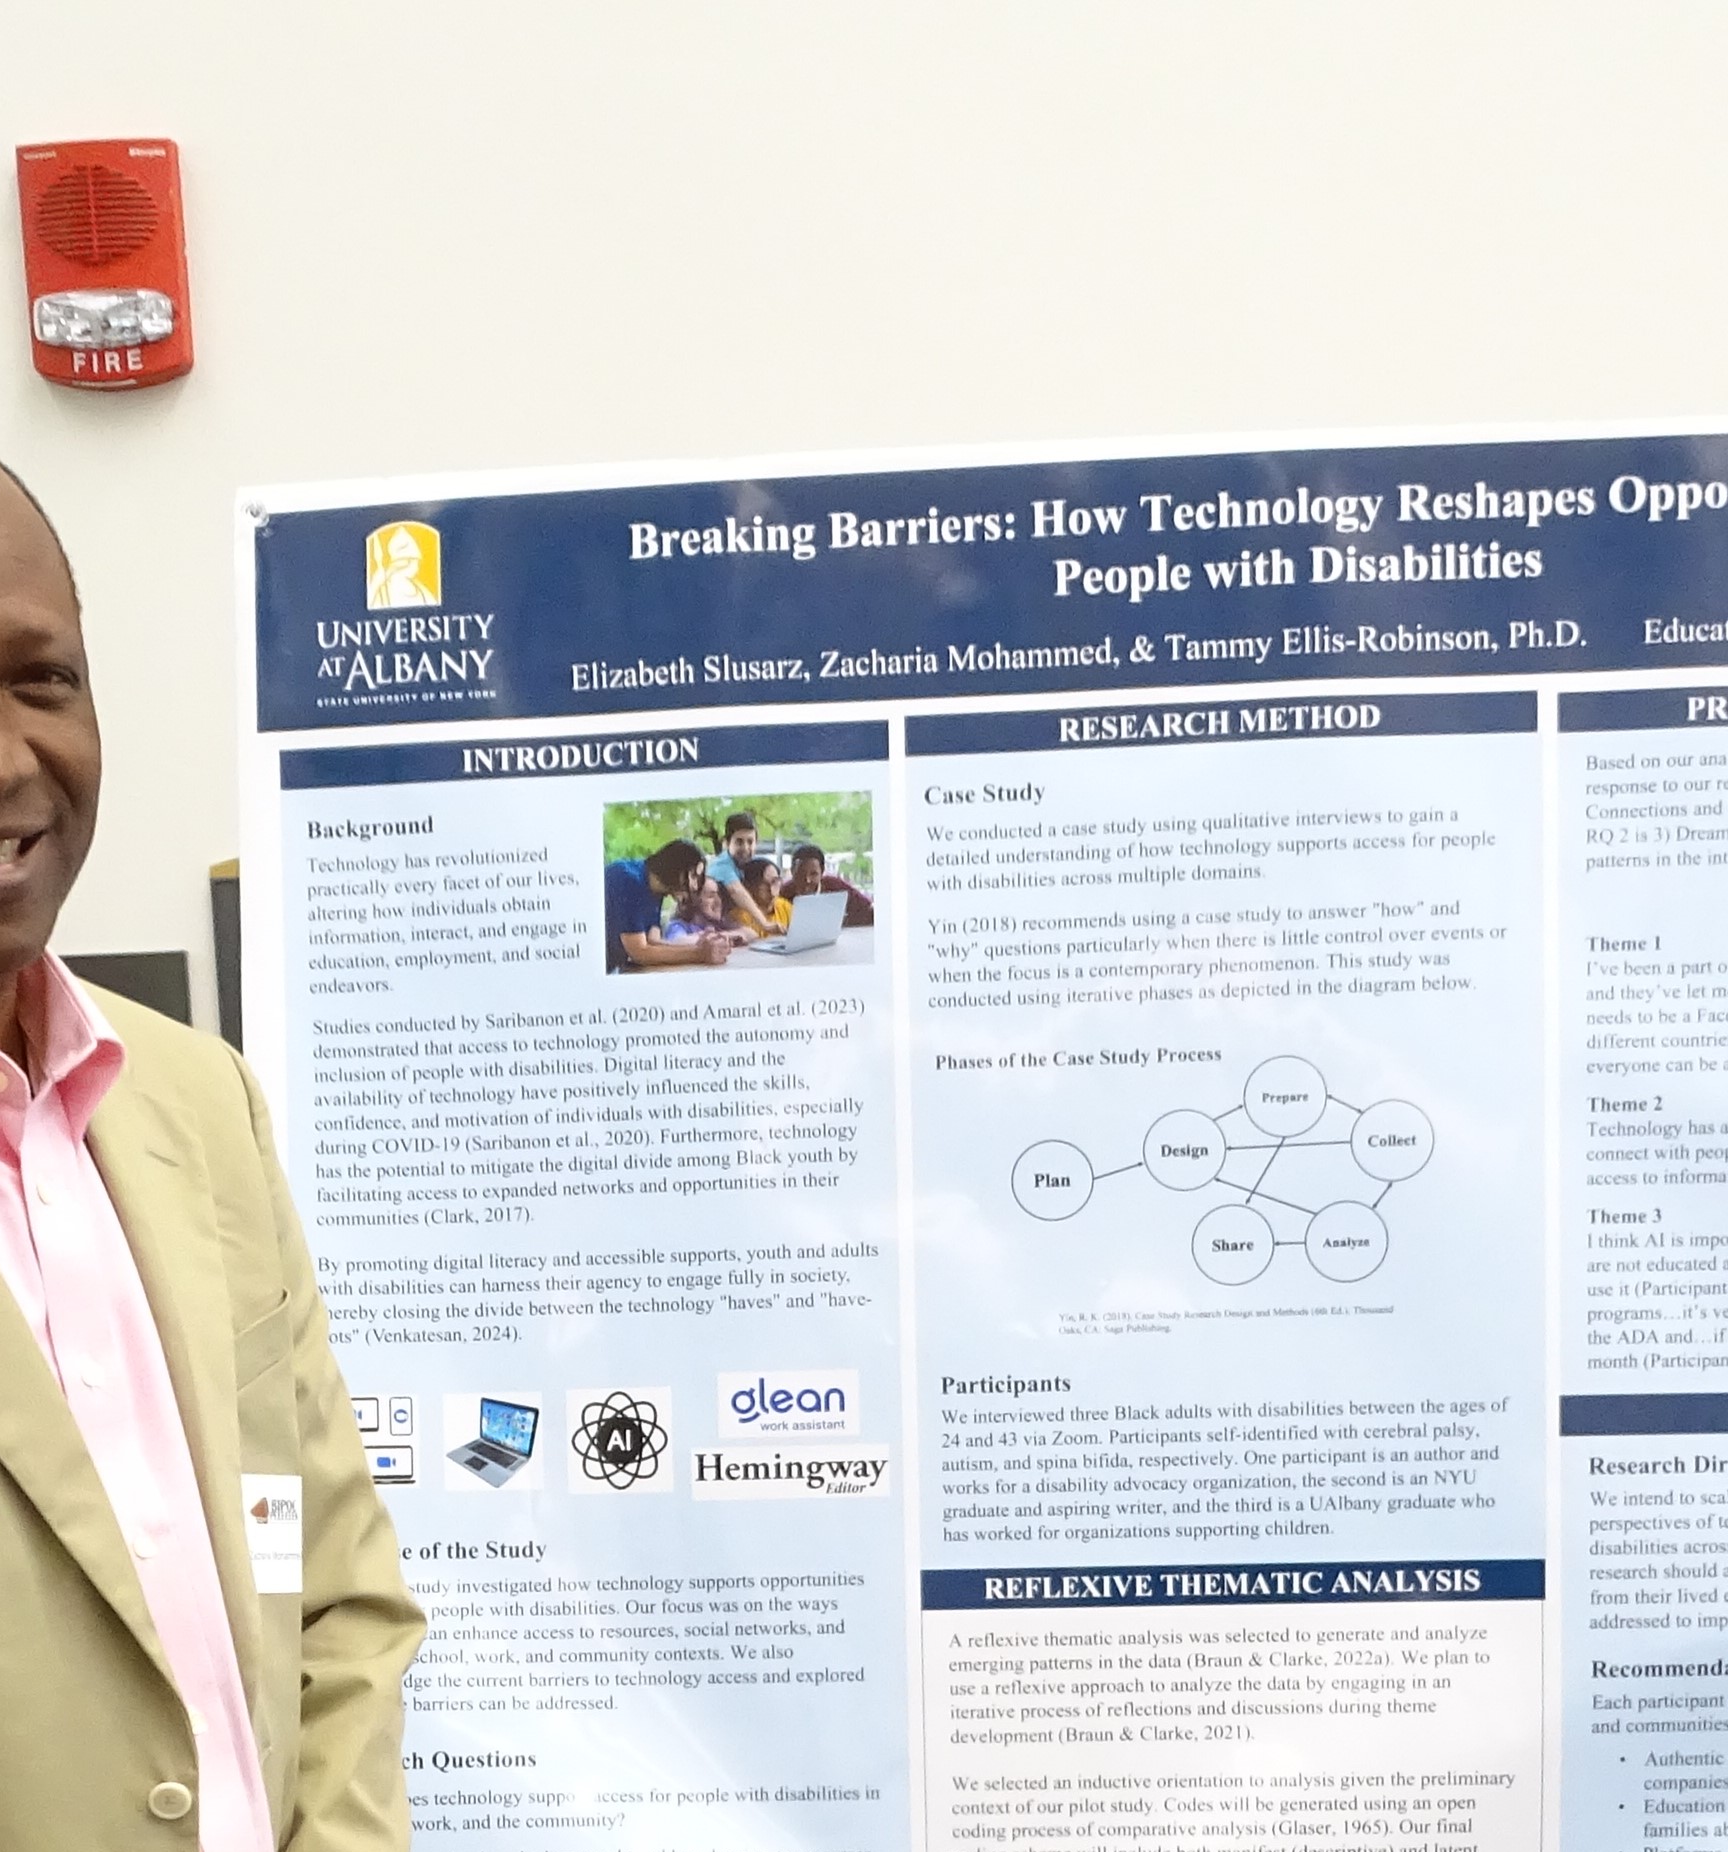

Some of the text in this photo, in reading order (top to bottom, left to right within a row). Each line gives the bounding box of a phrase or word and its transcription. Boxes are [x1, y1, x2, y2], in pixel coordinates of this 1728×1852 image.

[72, 349, 144, 374] FIRE
[629, 513, 817, 562] Breaking
[828, 505, 1016, 550] Barriers:
[1030, 498, 1128, 539] How
[1139, 485, 1384, 535] Technology
[1397, 480, 1596, 528] Reshapes
[1054, 540, 1543, 605] People with Disabilities
[316, 612, 495, 650] UNIVERSITY
[571, 618, 1587, 693] Elizabeth Slusarz, Zacharia Mohammed, & Tammy Ellis-Robinson, Ph.D.
[318, 649, 494, 691] AT ALBANY
[1060, 703, 1381, 743] RESEARCH METHOD
[462, 735, 699, 774] INTRODUCTION
[924, 781, 1045, 807] Case Study
[307, 814, 434, 841] Background
[306, 845, 548, 875] Technology has revolutionized
[1262, 1092, 1309, 1106] Prepare
[1160, 1143, 1209, 1161] Design
[1367, 1134, 1417, 1149] Collect
[1034, 1172, 1071, 1189] Plan
[1212, 1238, 1254, 1253] Share
[1322, 1236, 1370, 1250] Analyze
[942, 1374, 1071, 1400] Participants
[731, 1379, 845, 1423] glean
[760, 1419, 845, 1432] work assistant
[606, 1430, 633, 1452] AI
[695, 1453, 887, 1493] Hemingway
[1589, 1455, 1686, 1476] Research
[826, 1482, 867, 1495] Editor
[985, 1568, 1481, 1601] REFLEXIVE THEMATIC ANALYSIS
[950, 1724, 1255, 1748] development (Braun & Clarke, 2021).
